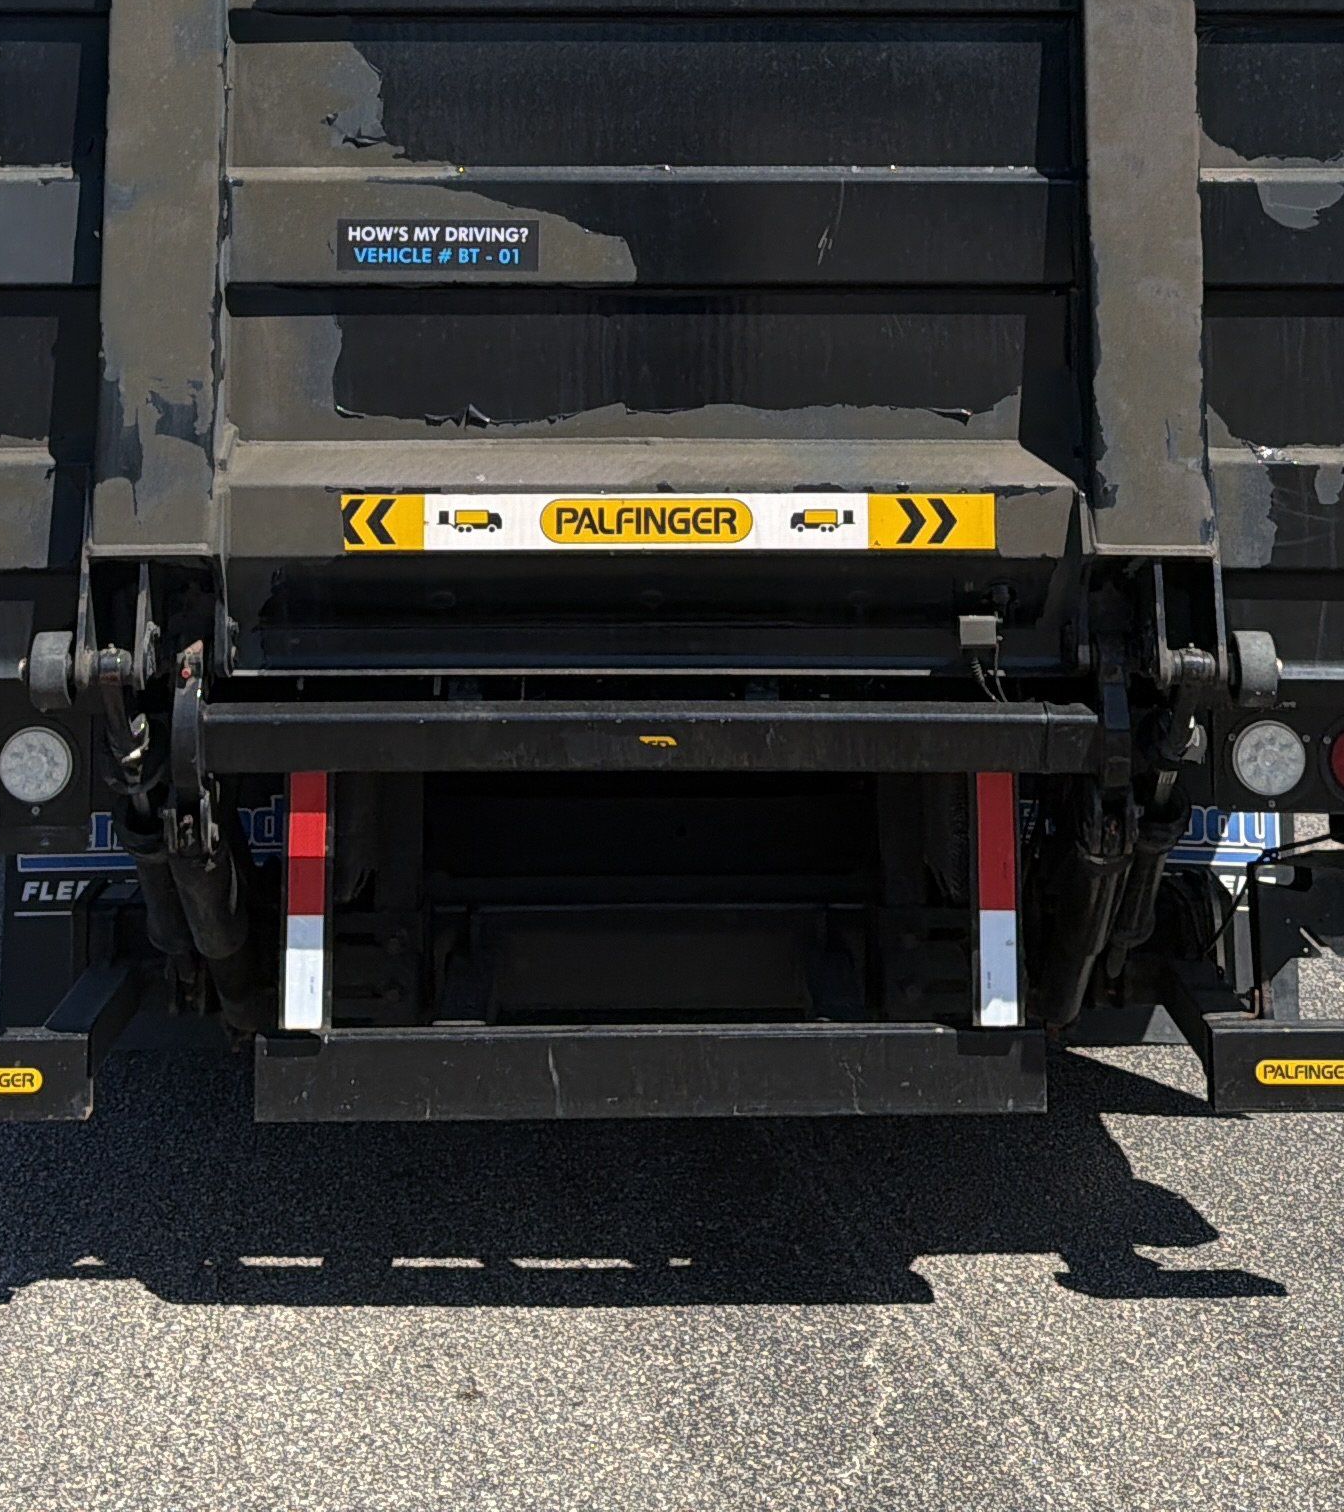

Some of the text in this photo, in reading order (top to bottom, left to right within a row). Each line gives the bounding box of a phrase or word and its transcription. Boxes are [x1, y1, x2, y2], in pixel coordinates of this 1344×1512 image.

[348, 226, 529, 243] HOW'S MY DRIVING?
[354, 247, 432, 264] VEHICLE
[437, 248, 453, 264] #
[458, 248, 481, 264] BT
[498, 248, 520, 264] 01
[556, 507, 737, 535] PALFINGER
